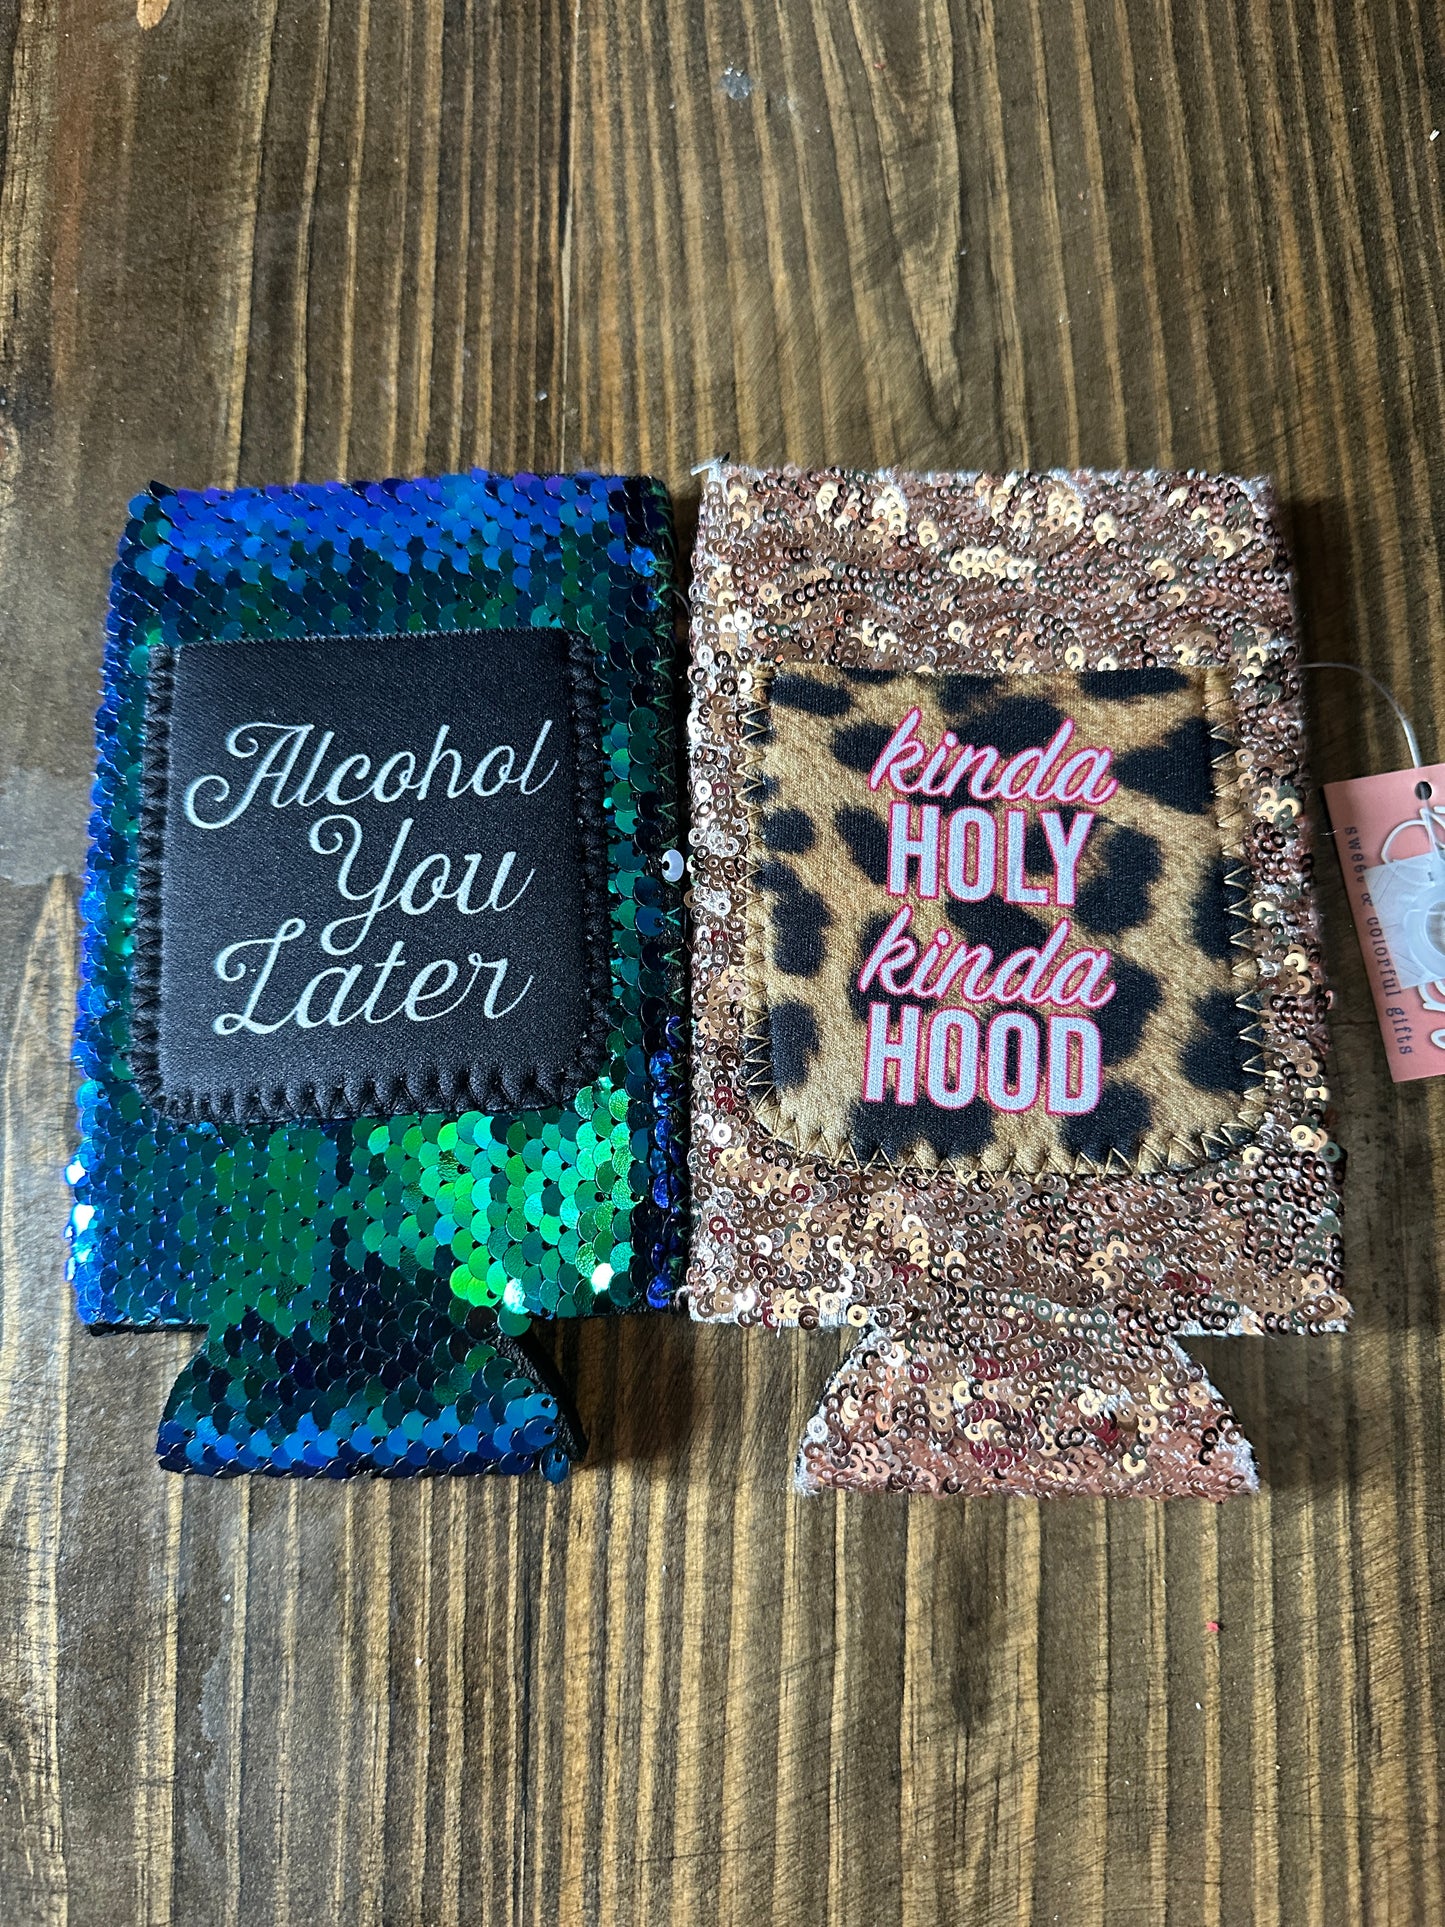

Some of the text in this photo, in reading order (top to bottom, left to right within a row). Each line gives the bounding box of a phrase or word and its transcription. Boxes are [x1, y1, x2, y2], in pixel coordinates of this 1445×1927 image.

[184, 720, 559, 829] Alcohol
[868, 706, 1118, 806] kinda
[309, 814, 535, 955] You
[887, 800, 1095, 907] HOLY
[213, 918, 534, 1035] Later
[858, 904, 1117, 1008] kinda
[1366, 917, 1402, 998] colorful
[1385, 1008, 1413, 1055] gifts
[863, 1002, 1104, 1117] HOOD
